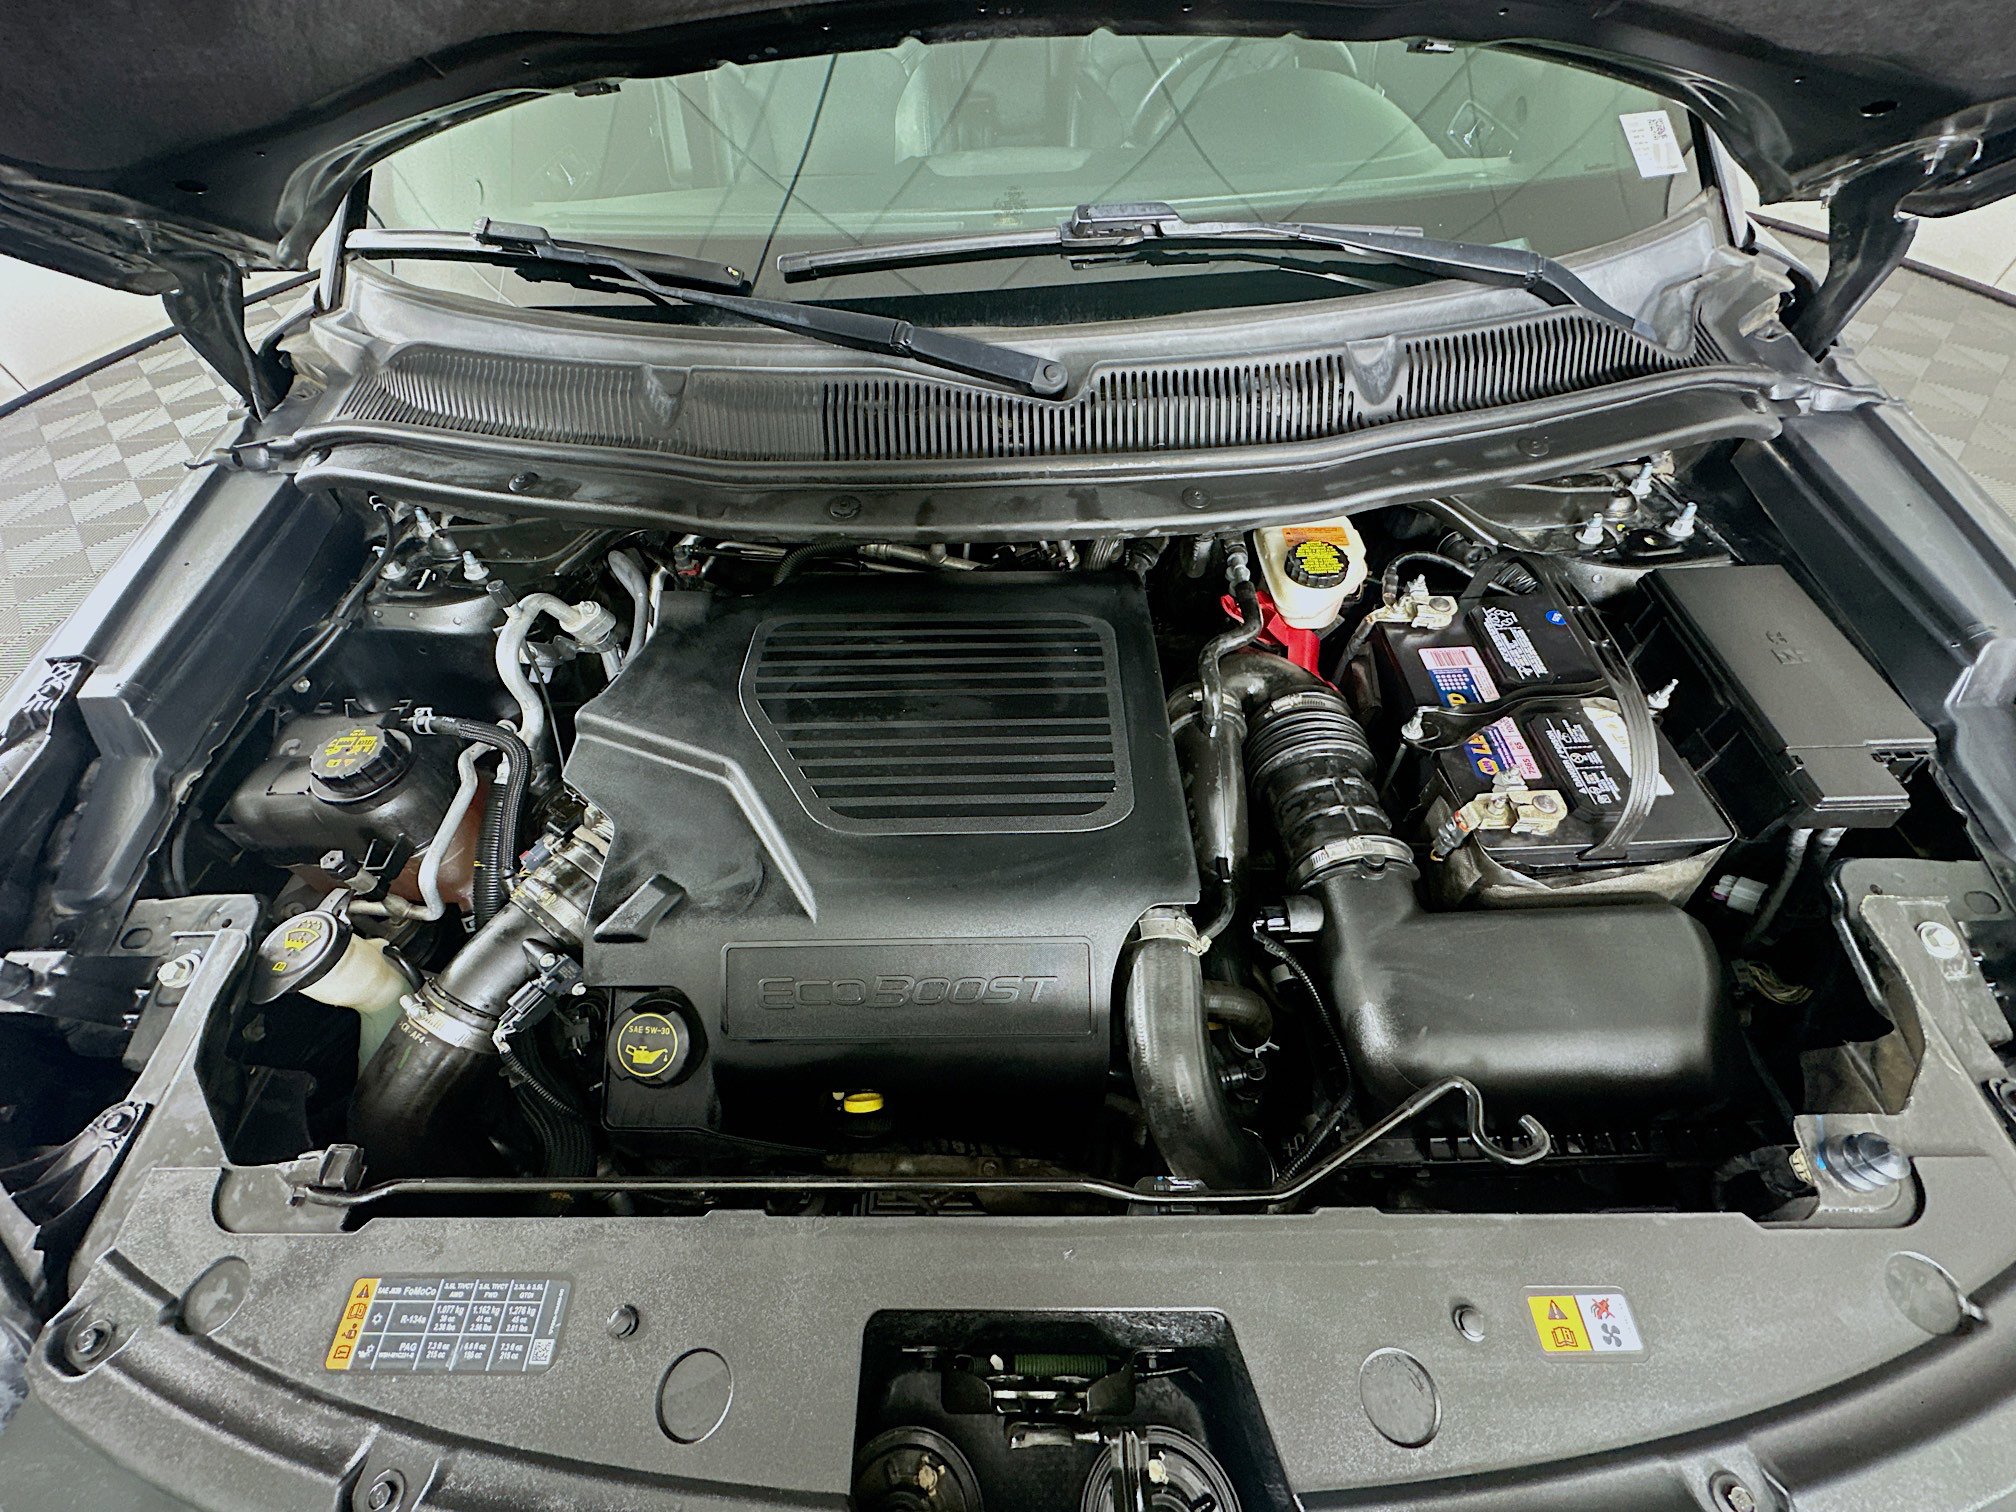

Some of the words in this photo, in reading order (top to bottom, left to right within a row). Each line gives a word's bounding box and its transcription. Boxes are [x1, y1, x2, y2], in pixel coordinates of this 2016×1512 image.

[1514, 742, 1525, 750] 65
[1522, 758, 1536, 775] 7565
[628, 1025, 644, 1034] SAE
[645, 1026, 671, 1035] 5W-30
[403, 1286, 437, 1296] FoMoCo
[436, 1304, 455, 1314] 1.077
[455, 1305, 464, 1316] kg
[473, 1305, 491, 1314] 1.162
[491, 1305, 501, 1317] kg
[527, 1306, 537, 1317] kg
[400, 1314, 427, 1324] R-134a
[398, 1342, 418, 1352] PAG
[427, 1341, 437, 1350] 7.3
